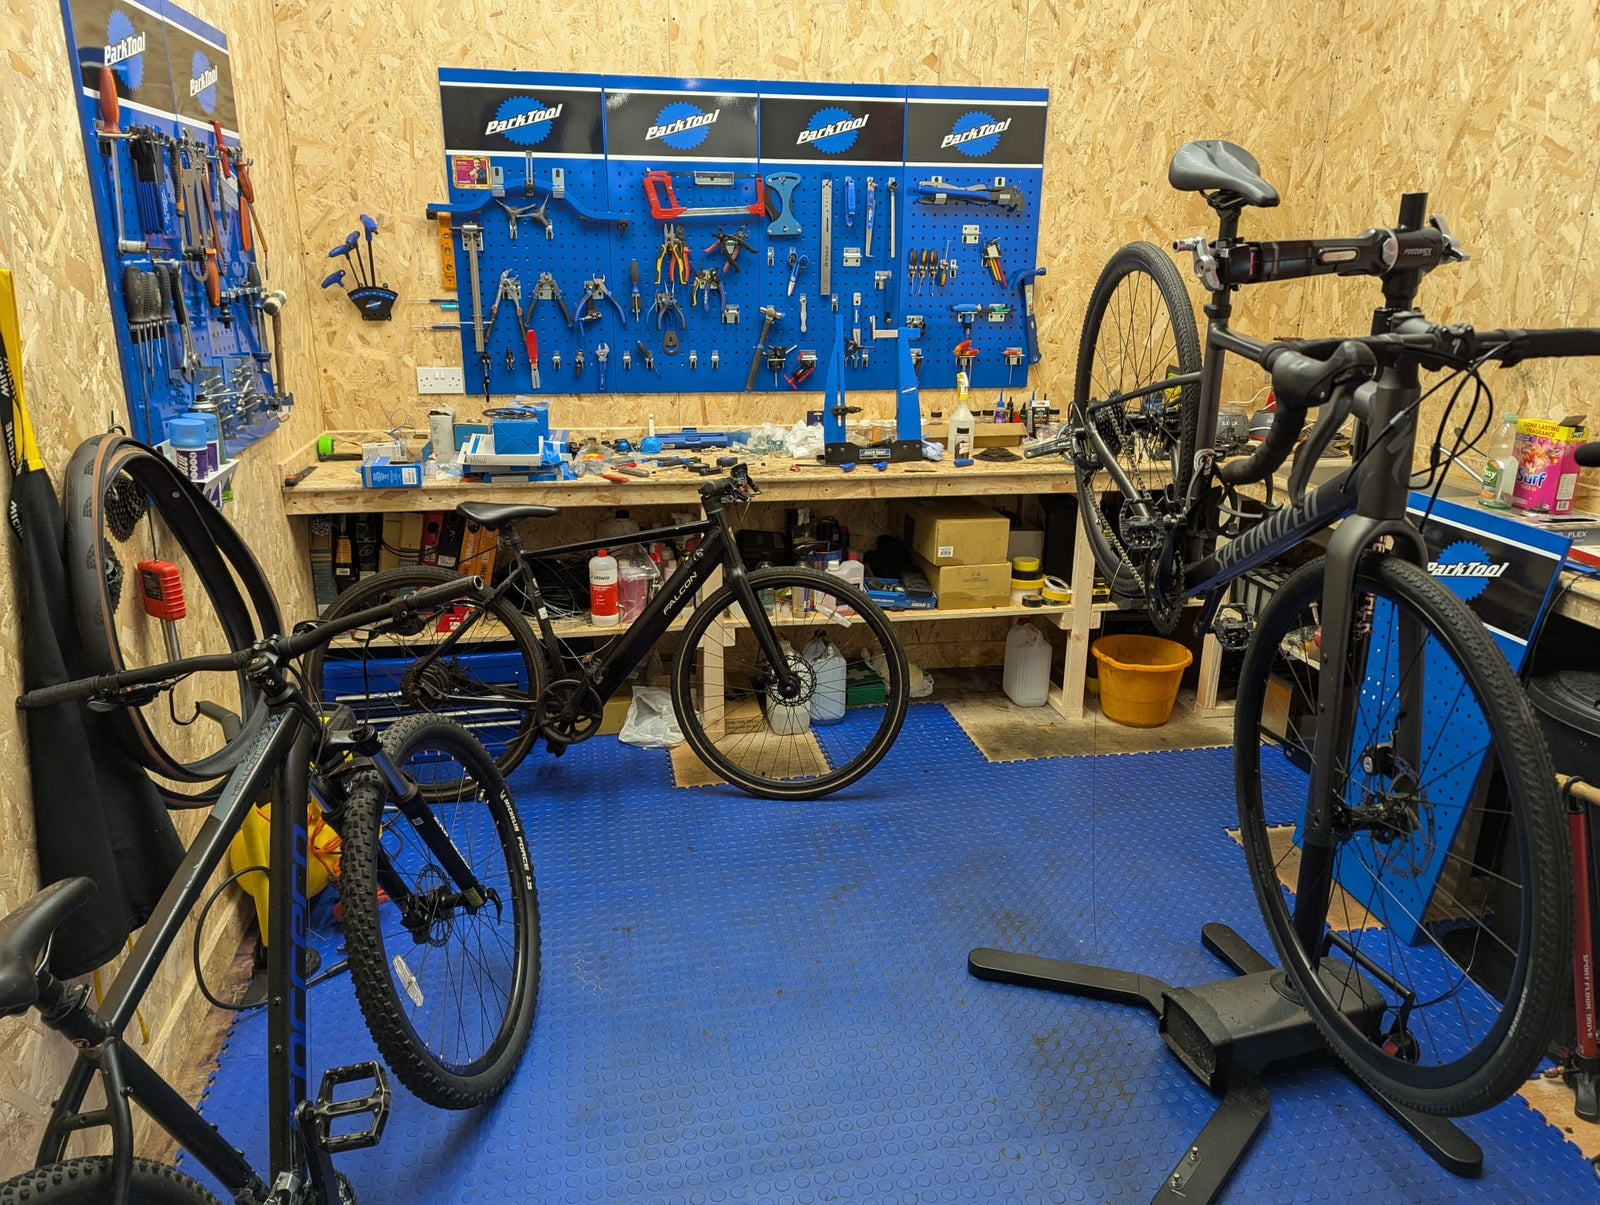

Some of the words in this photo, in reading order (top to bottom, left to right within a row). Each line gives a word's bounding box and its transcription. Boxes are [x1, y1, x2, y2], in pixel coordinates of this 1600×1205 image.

[485, 103, 563, 136] ParkTool
[644, 109, 721, 141] ParkTool
[796, 113, 870, 145] ParkTool
[940, 118, 1013, 149] ParkTool
[1526, 428, 1555, 437] FRAGRANCE
[1539, 424, 1560, 432] LASTING
[1517, 466, 1548, 488] Surf
[1214, 487, 1320, 573] SPECIALIZED
[663, 571, 698, 615] FALCON
[503, 798, 520, 832] MICHELIN
[516, 835, 530, 871] FORCE
[1582, 954, 1590, 980] SPORT
[1584, 982, 1592, 1010] FLOOR
[1585, 1013, 1594, 1039] DRIVE
